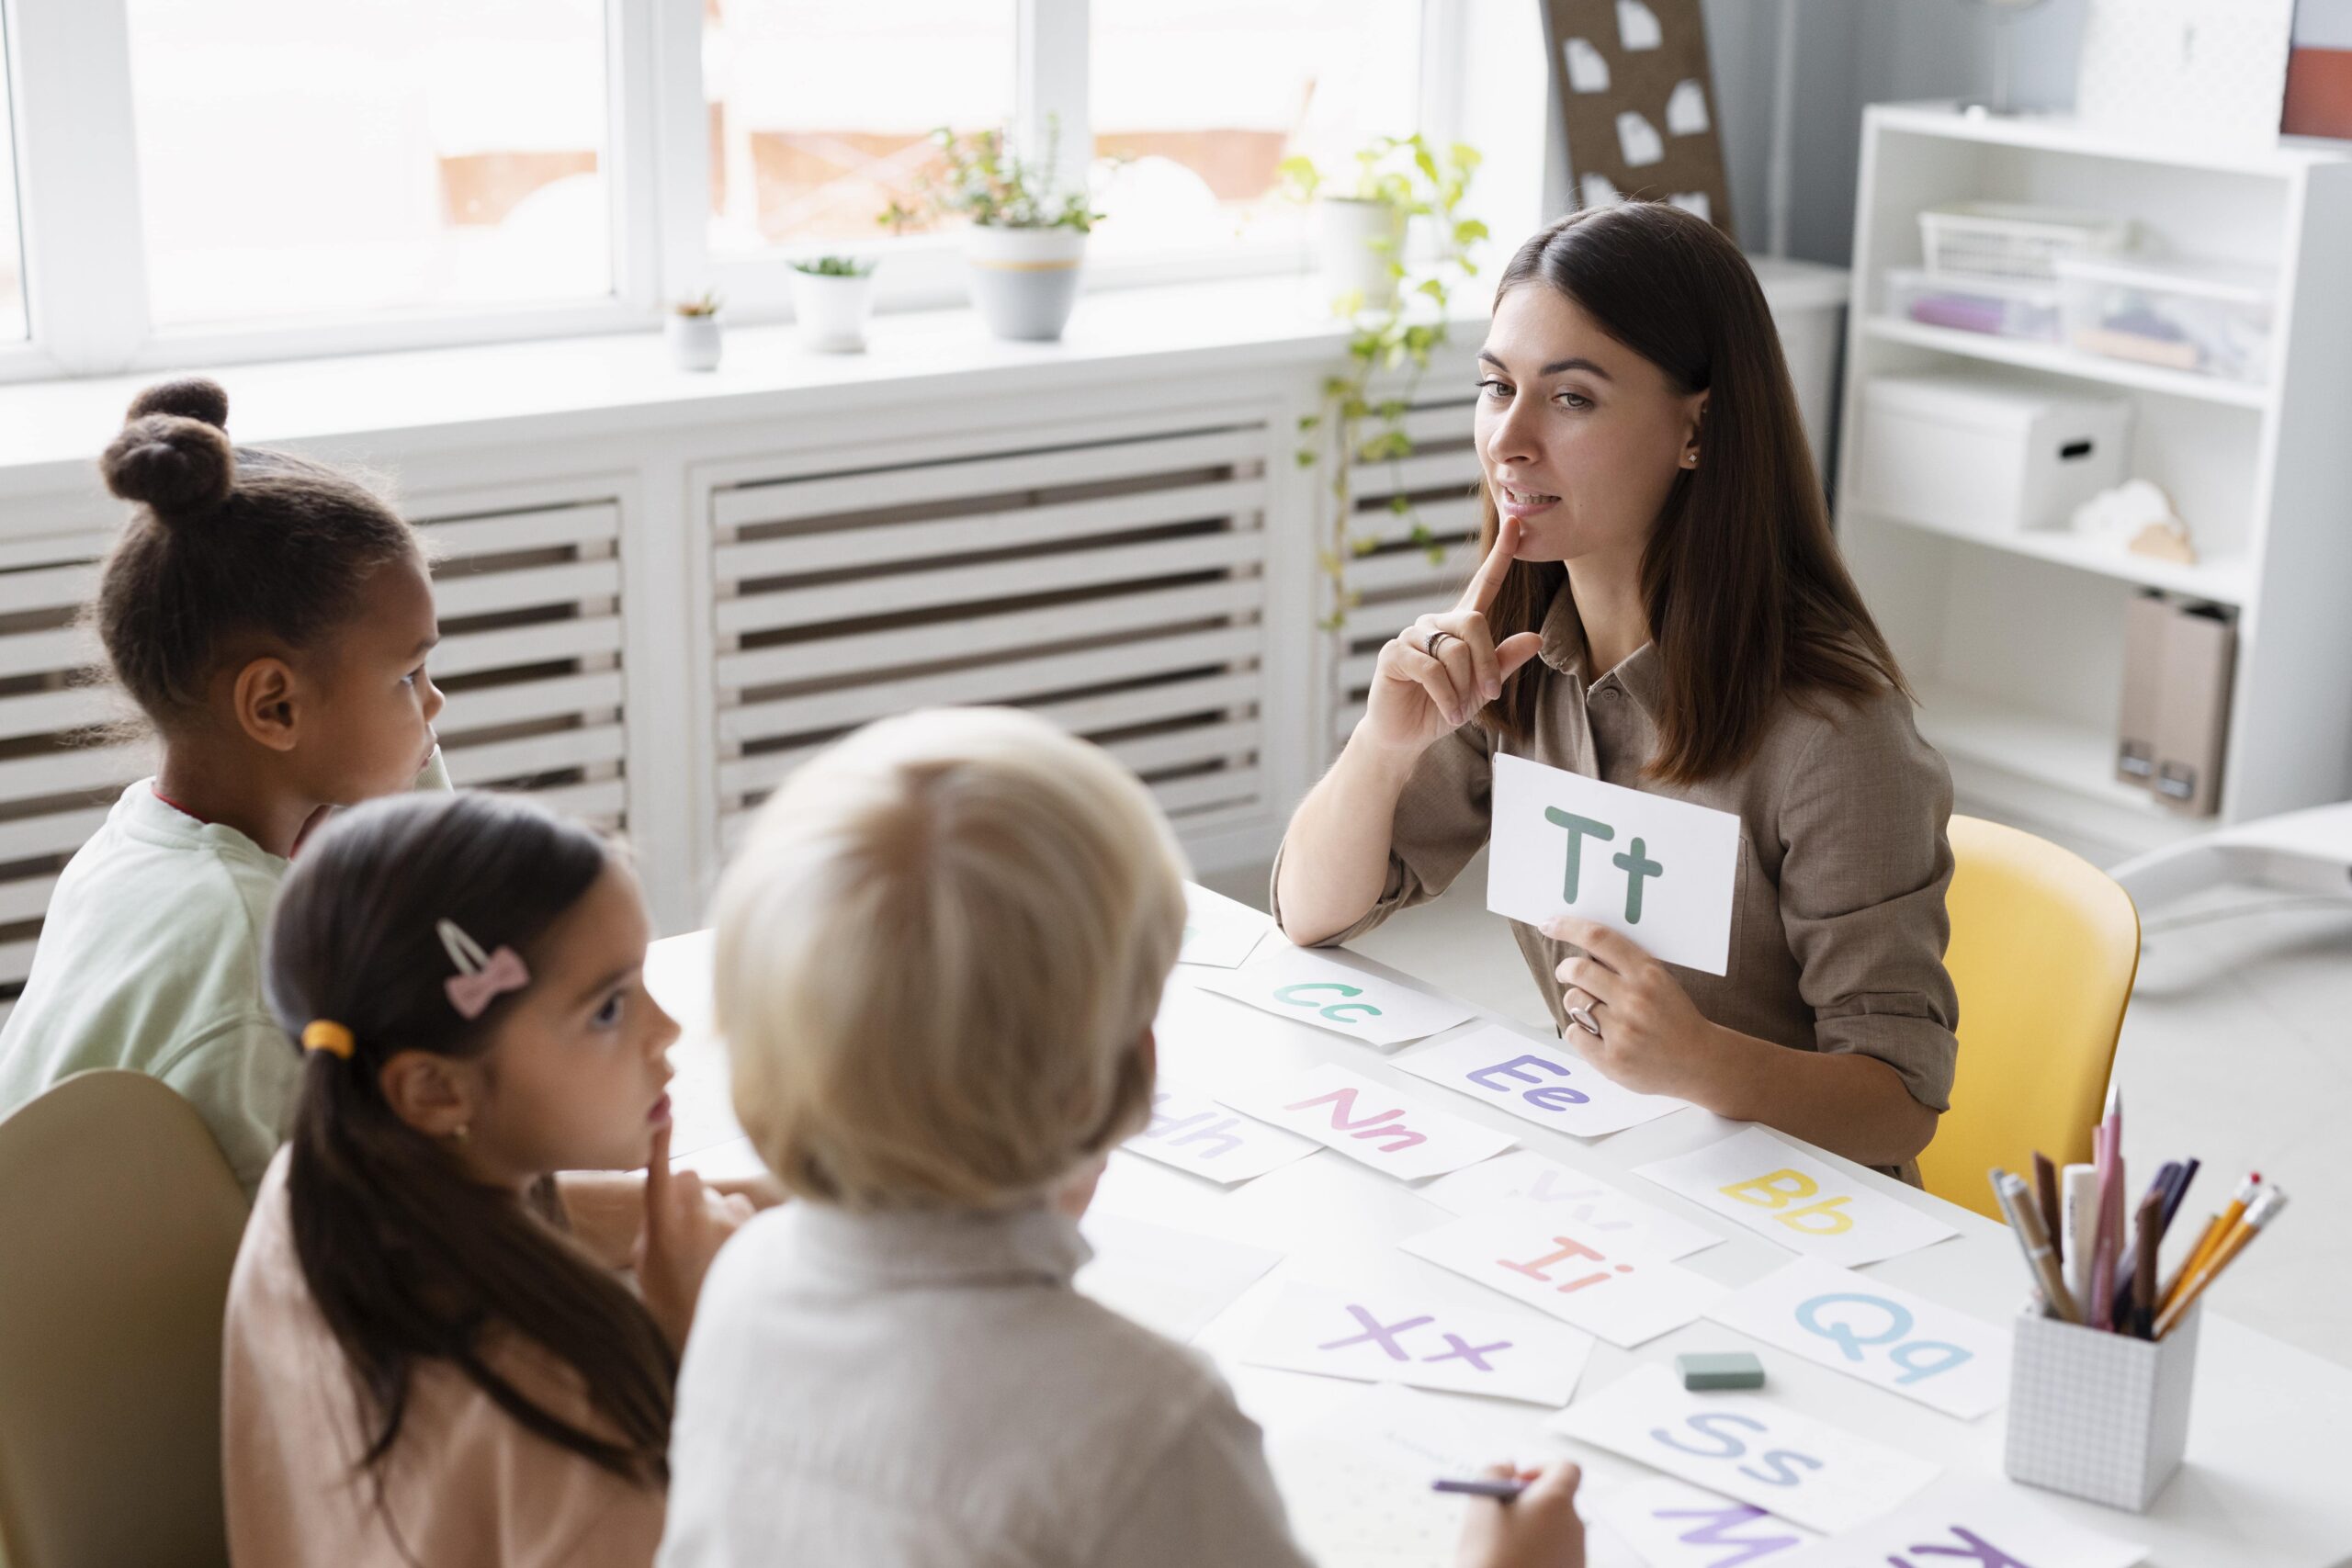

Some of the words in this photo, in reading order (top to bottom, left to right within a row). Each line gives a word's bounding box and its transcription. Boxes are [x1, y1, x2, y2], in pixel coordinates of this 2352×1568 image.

[1544, 806, 1663, 924] Tt
[1272, 983, 1382, 1023] Cc
[1465, 1055, 1590, 1112] Ee
[1283, 1088, 1427, 1153] Nn
[1717, 1168, 1854, 1235] Bb
[1496, 1235, 1634, 1293] Ii
[1317, 1304, 1514, 1372] Xx
[1794, 1292, 1974, 1383] Qq
[1650, 1412, 1824, 1487] Ss
